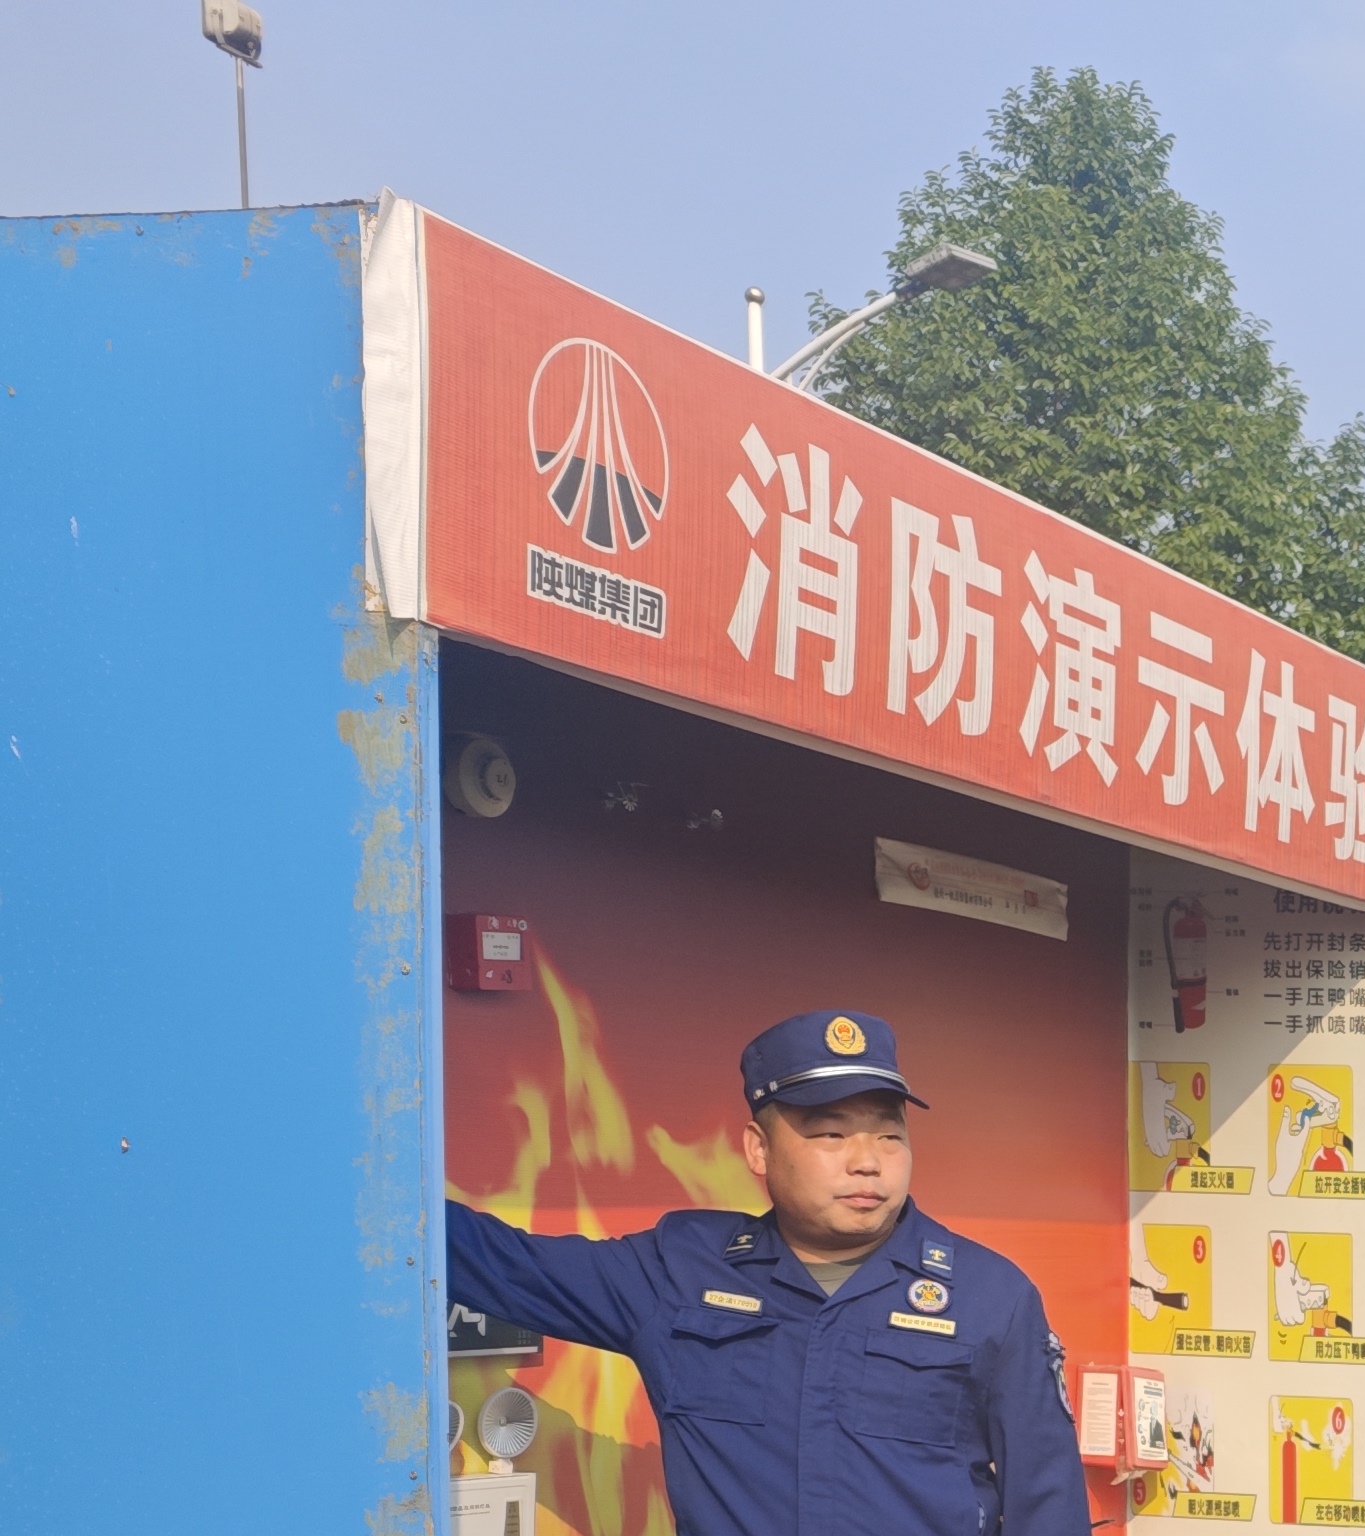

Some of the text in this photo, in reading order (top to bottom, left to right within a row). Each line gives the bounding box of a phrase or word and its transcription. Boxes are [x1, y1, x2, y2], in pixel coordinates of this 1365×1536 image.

[528, 546, 664, 637] 陕煤集团
[1273, 888, 1365, 914] 使用
[1274, 1078, 1282, 1099] 2
[1190, 1170, 1235, 1189] 提起灭火器
[1196, 1240, 1204, 1259] 3
[1274, 1243, 1283, 1262] 4
